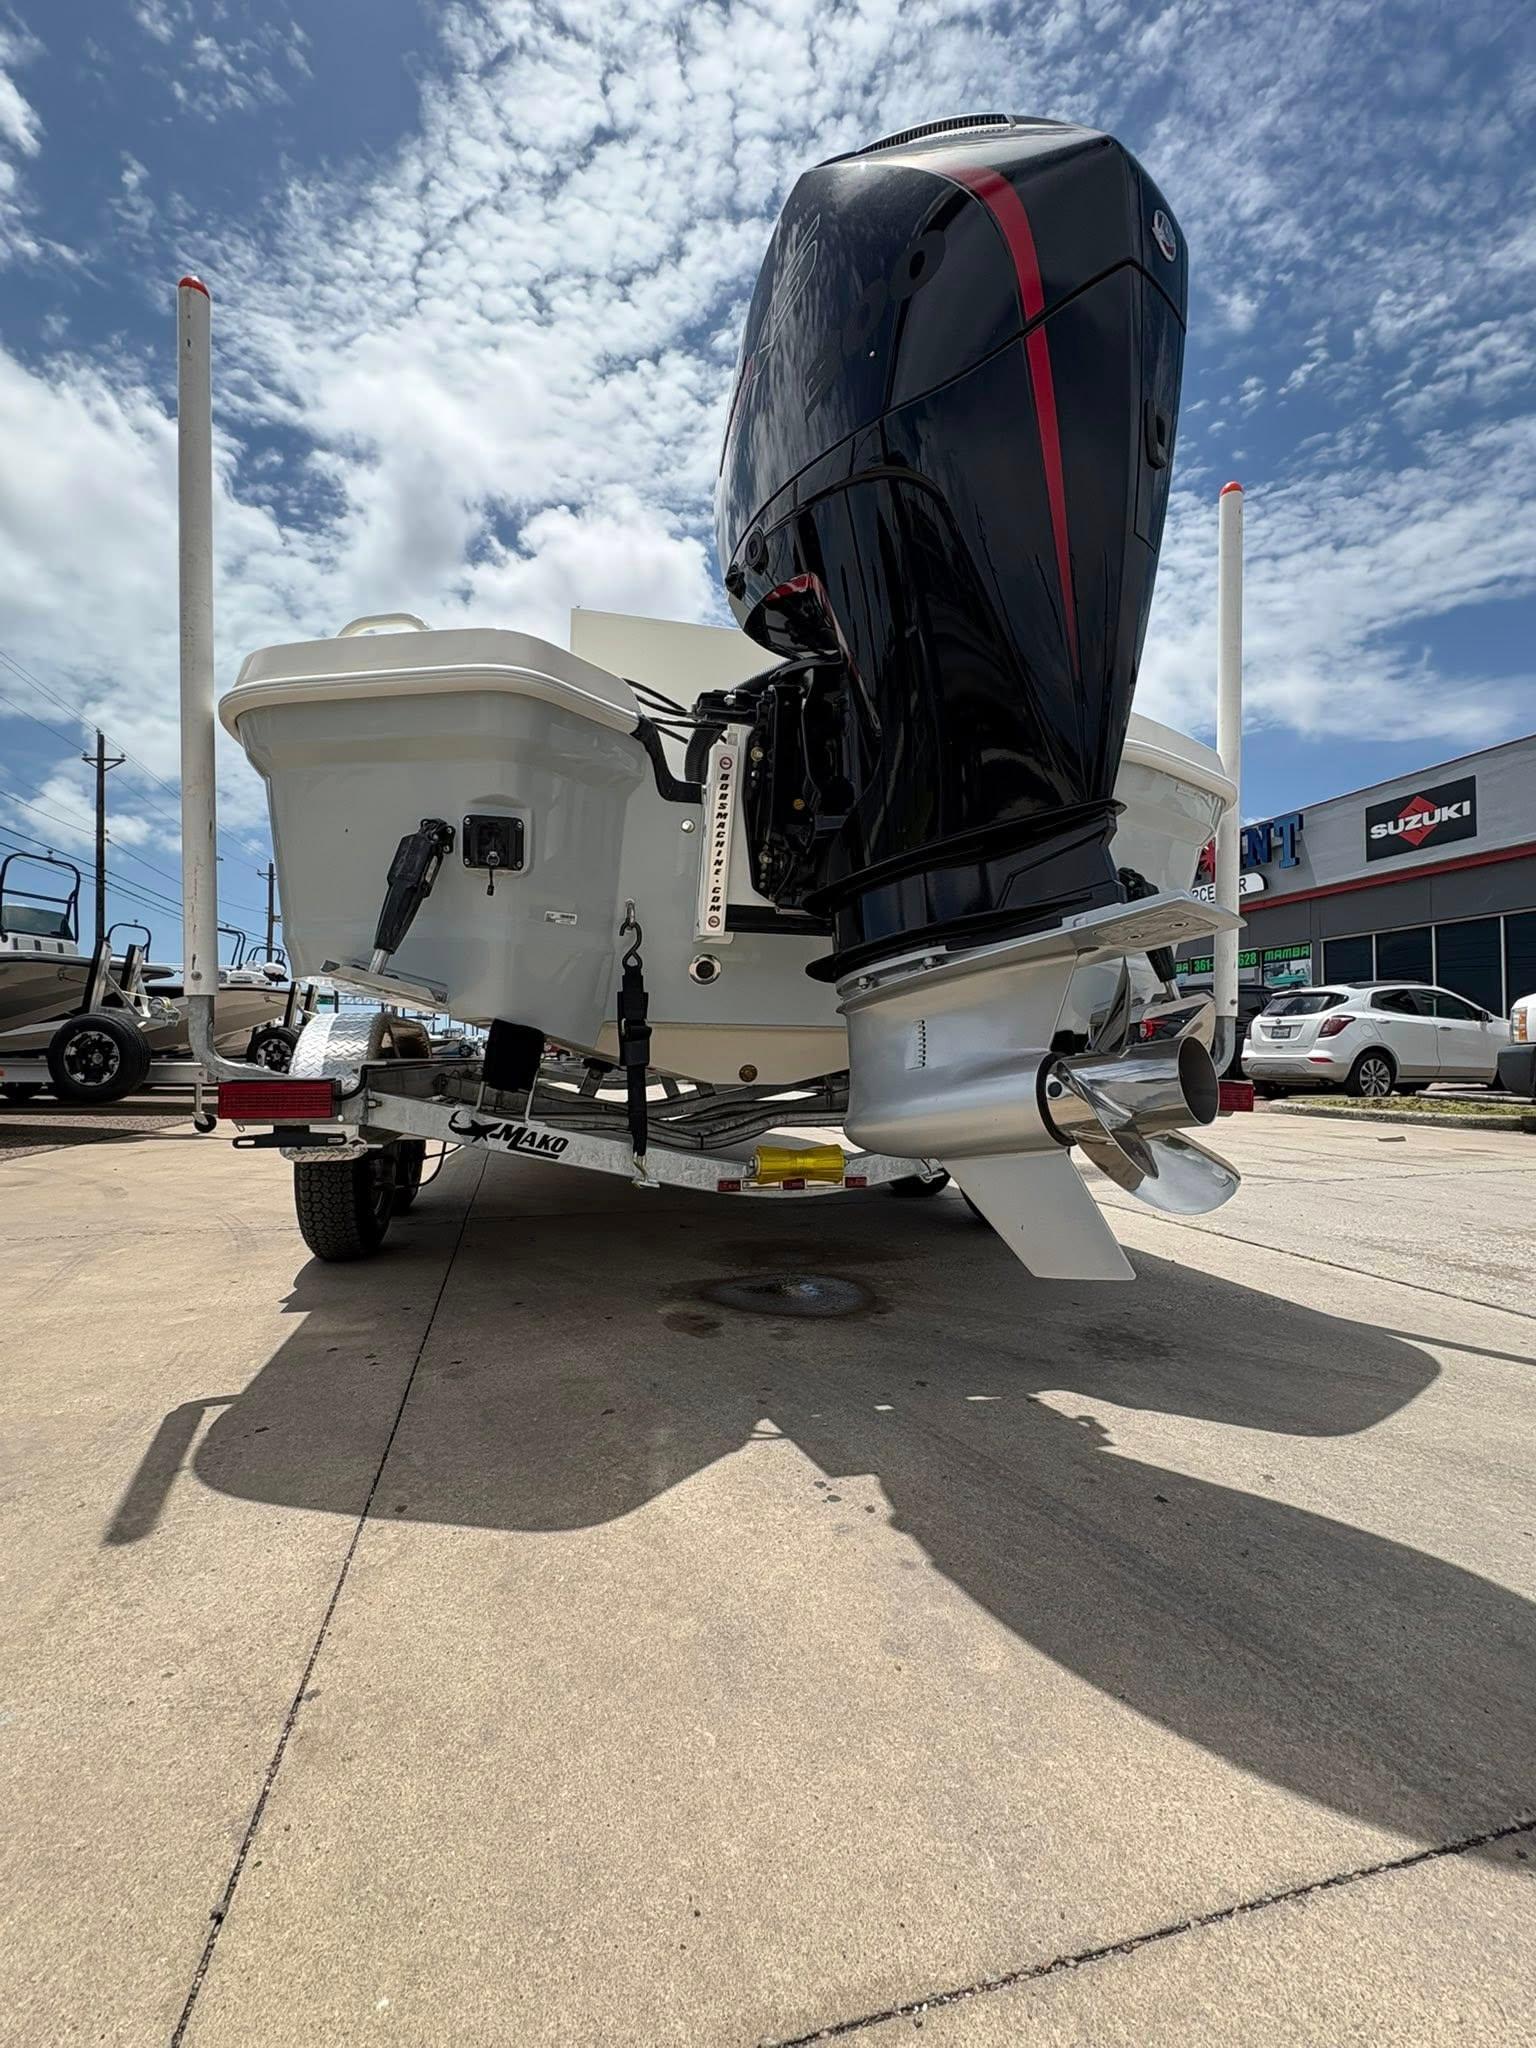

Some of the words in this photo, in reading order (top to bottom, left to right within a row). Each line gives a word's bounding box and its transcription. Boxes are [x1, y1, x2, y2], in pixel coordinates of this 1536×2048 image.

[1370, 800, 1471, 839] SUZUKI
[709, 773, 730, 912] BOBSMACHINE.COM
[1264, 945, 1310, 960] MAMBA
[489, 1123, 569, 1159] MAKO
